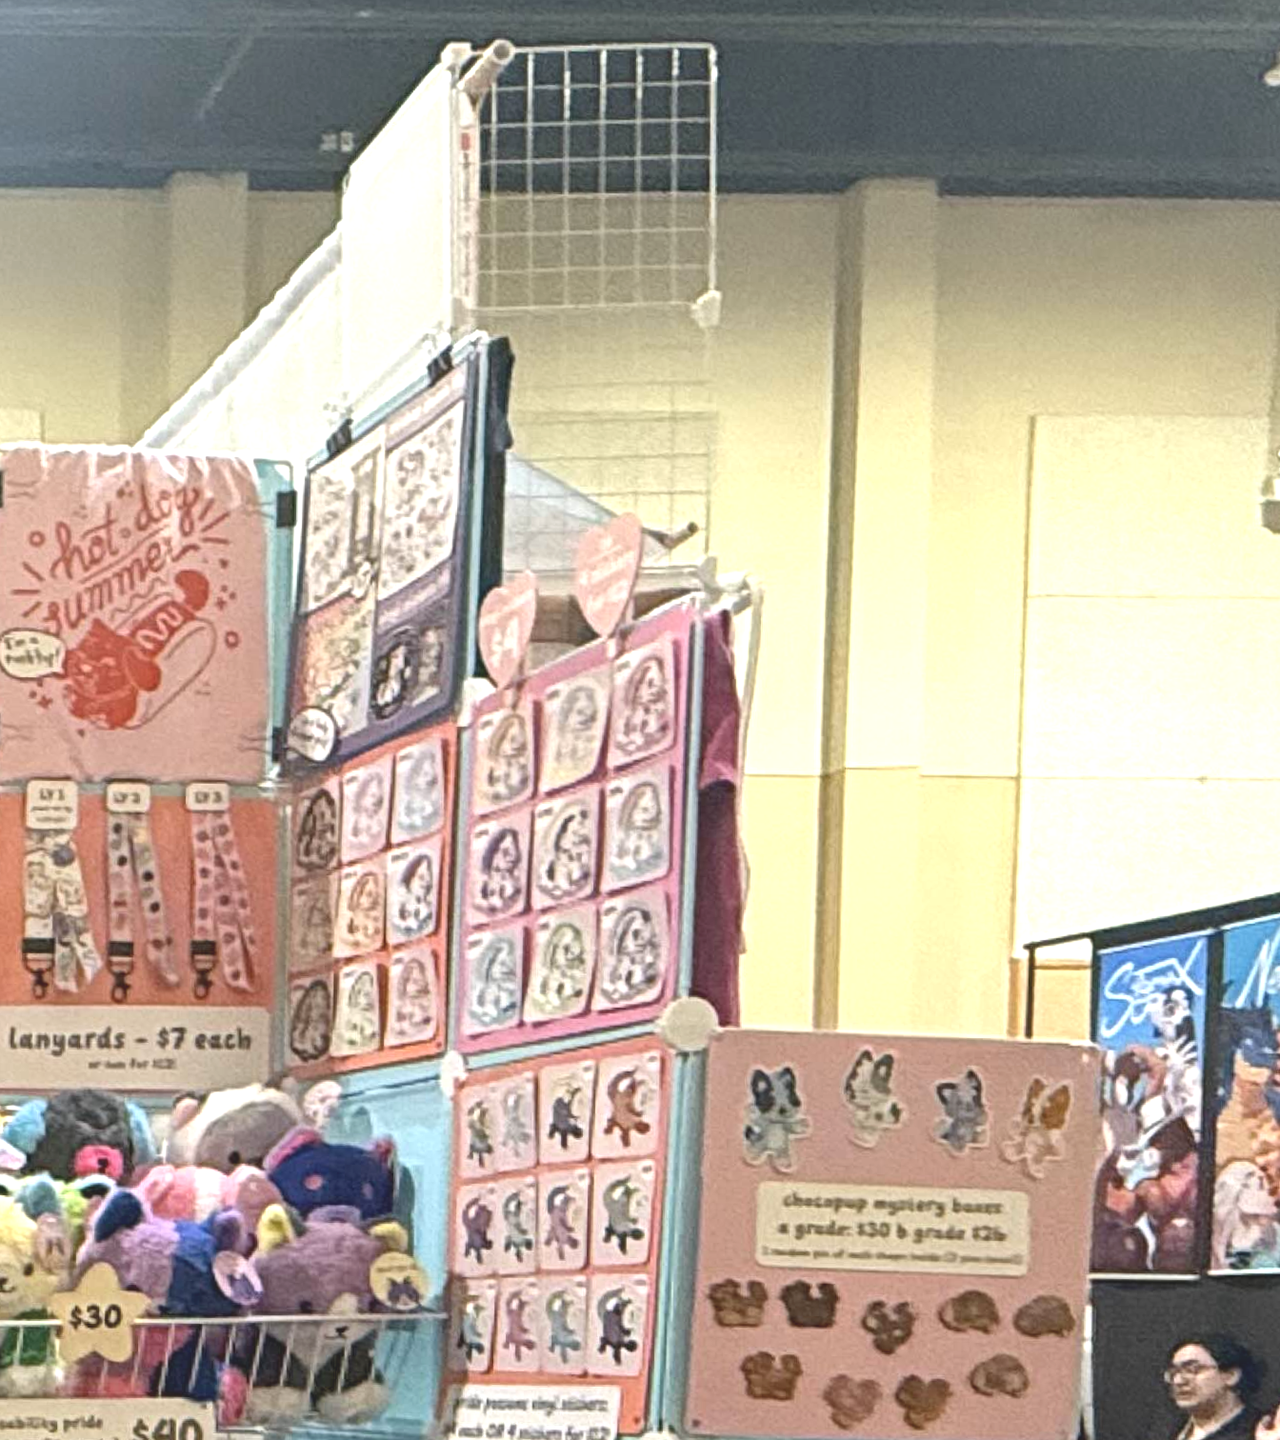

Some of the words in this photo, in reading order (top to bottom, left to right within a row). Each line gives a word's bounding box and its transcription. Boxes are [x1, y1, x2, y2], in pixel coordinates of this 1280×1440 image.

[50, 503, 118, 580] hot
[135, 483, 200, 537] dog
[9, 1027, 126, 1056] lanyards
[156, 1028, 187, 1050] $7
[194, 1028, 252, 1051] each
[873, 1198, 946, 1218] mystery
[68, 1304, 124, 1331] $30
[63, 1414, 104, 1433] pride
